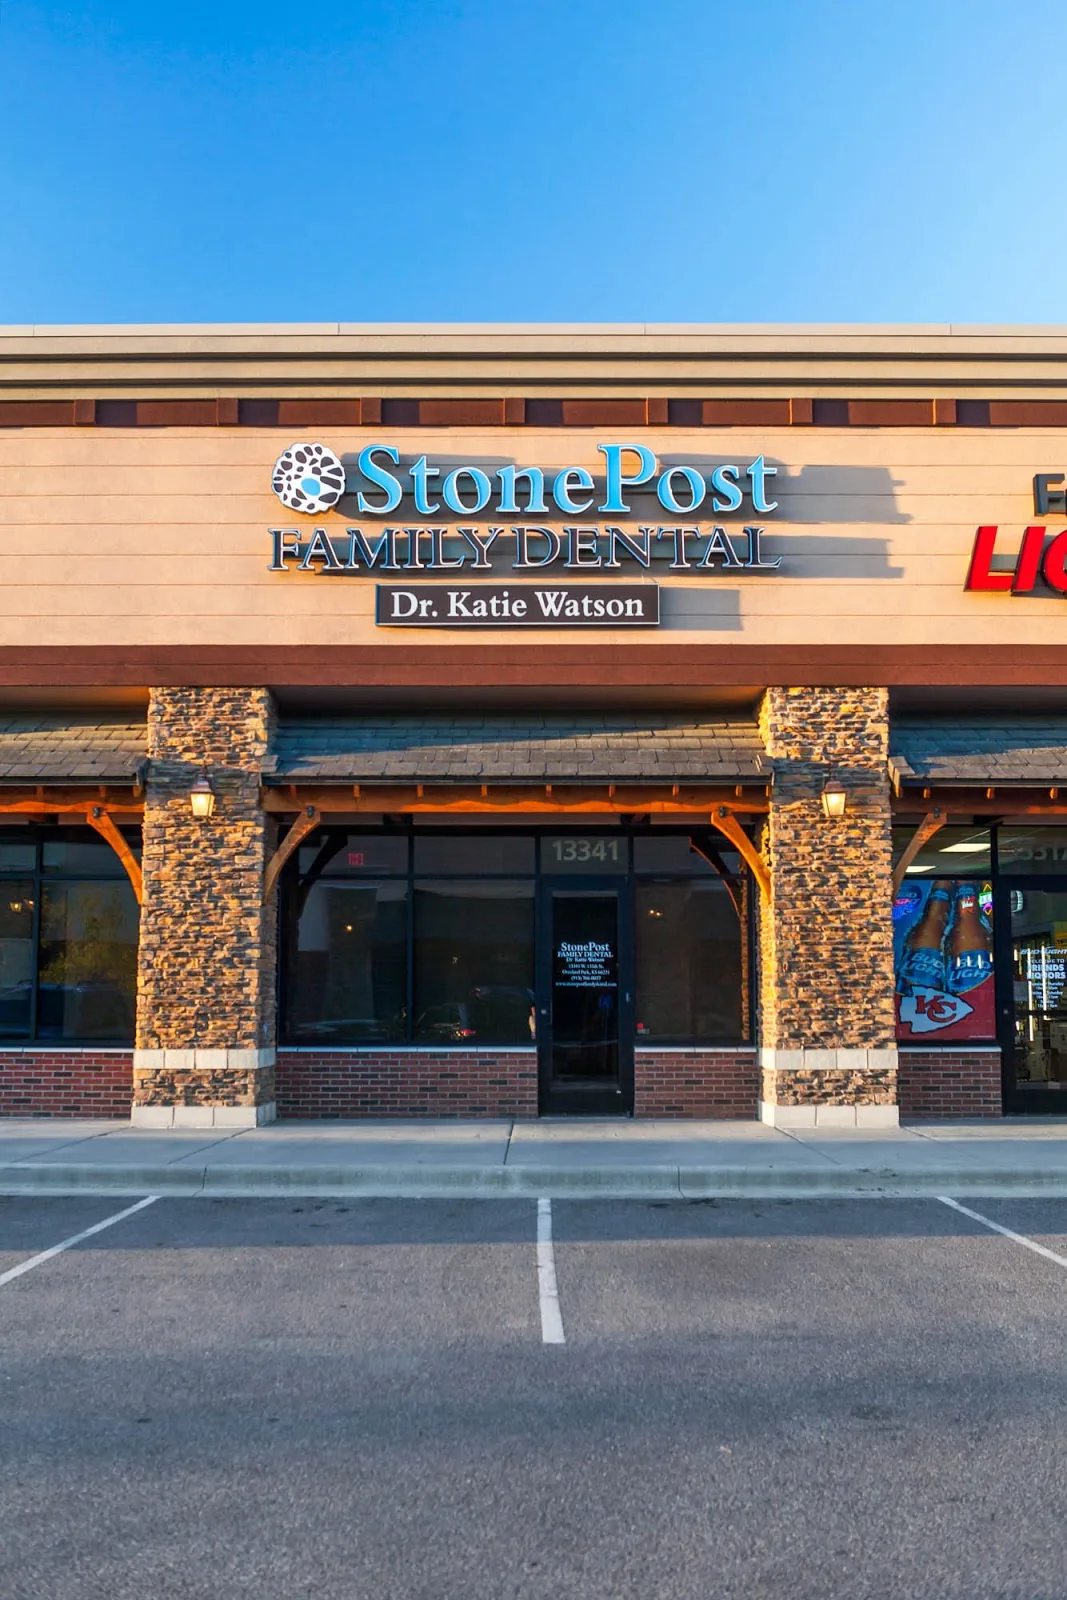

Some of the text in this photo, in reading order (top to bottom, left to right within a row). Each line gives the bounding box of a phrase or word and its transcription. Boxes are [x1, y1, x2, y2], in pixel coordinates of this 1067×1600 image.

[357, 443, 779, 515] StonePost
[1033, 473, 1067, 517] F
[267, 525, 783, 570] FAMILY DENTAL
[390, 590, 645, 618] Dr. Katie Watson
[551, 839, 619, 861] 13341
[561, 941, 610, 951] StonePost
[1027, 964, 1065, 972] RINDS
[915, 995, 957, 1023] KC
